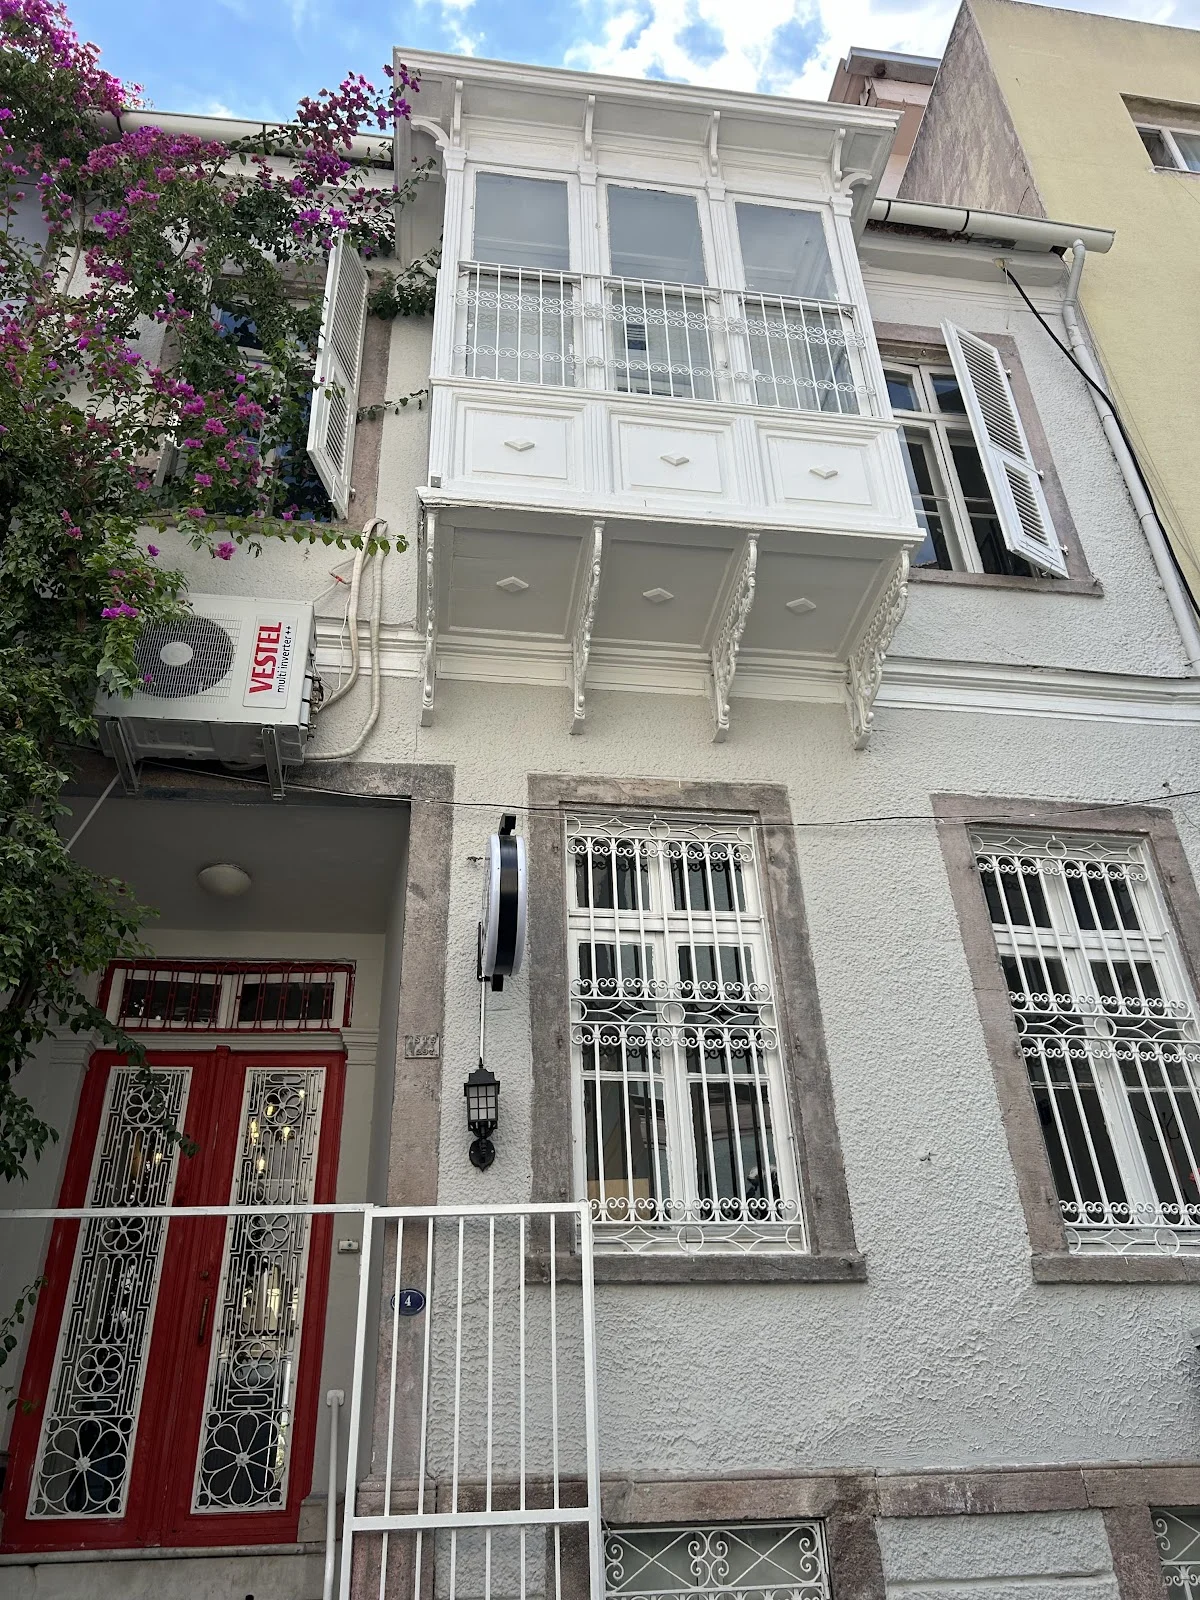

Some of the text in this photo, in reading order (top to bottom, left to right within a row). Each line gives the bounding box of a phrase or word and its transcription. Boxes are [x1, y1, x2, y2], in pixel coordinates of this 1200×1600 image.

[249, 622, 282, 693] VESTEL
[276, 670, 286, 693] multi
[404, 1295, 411, 1306] 4
